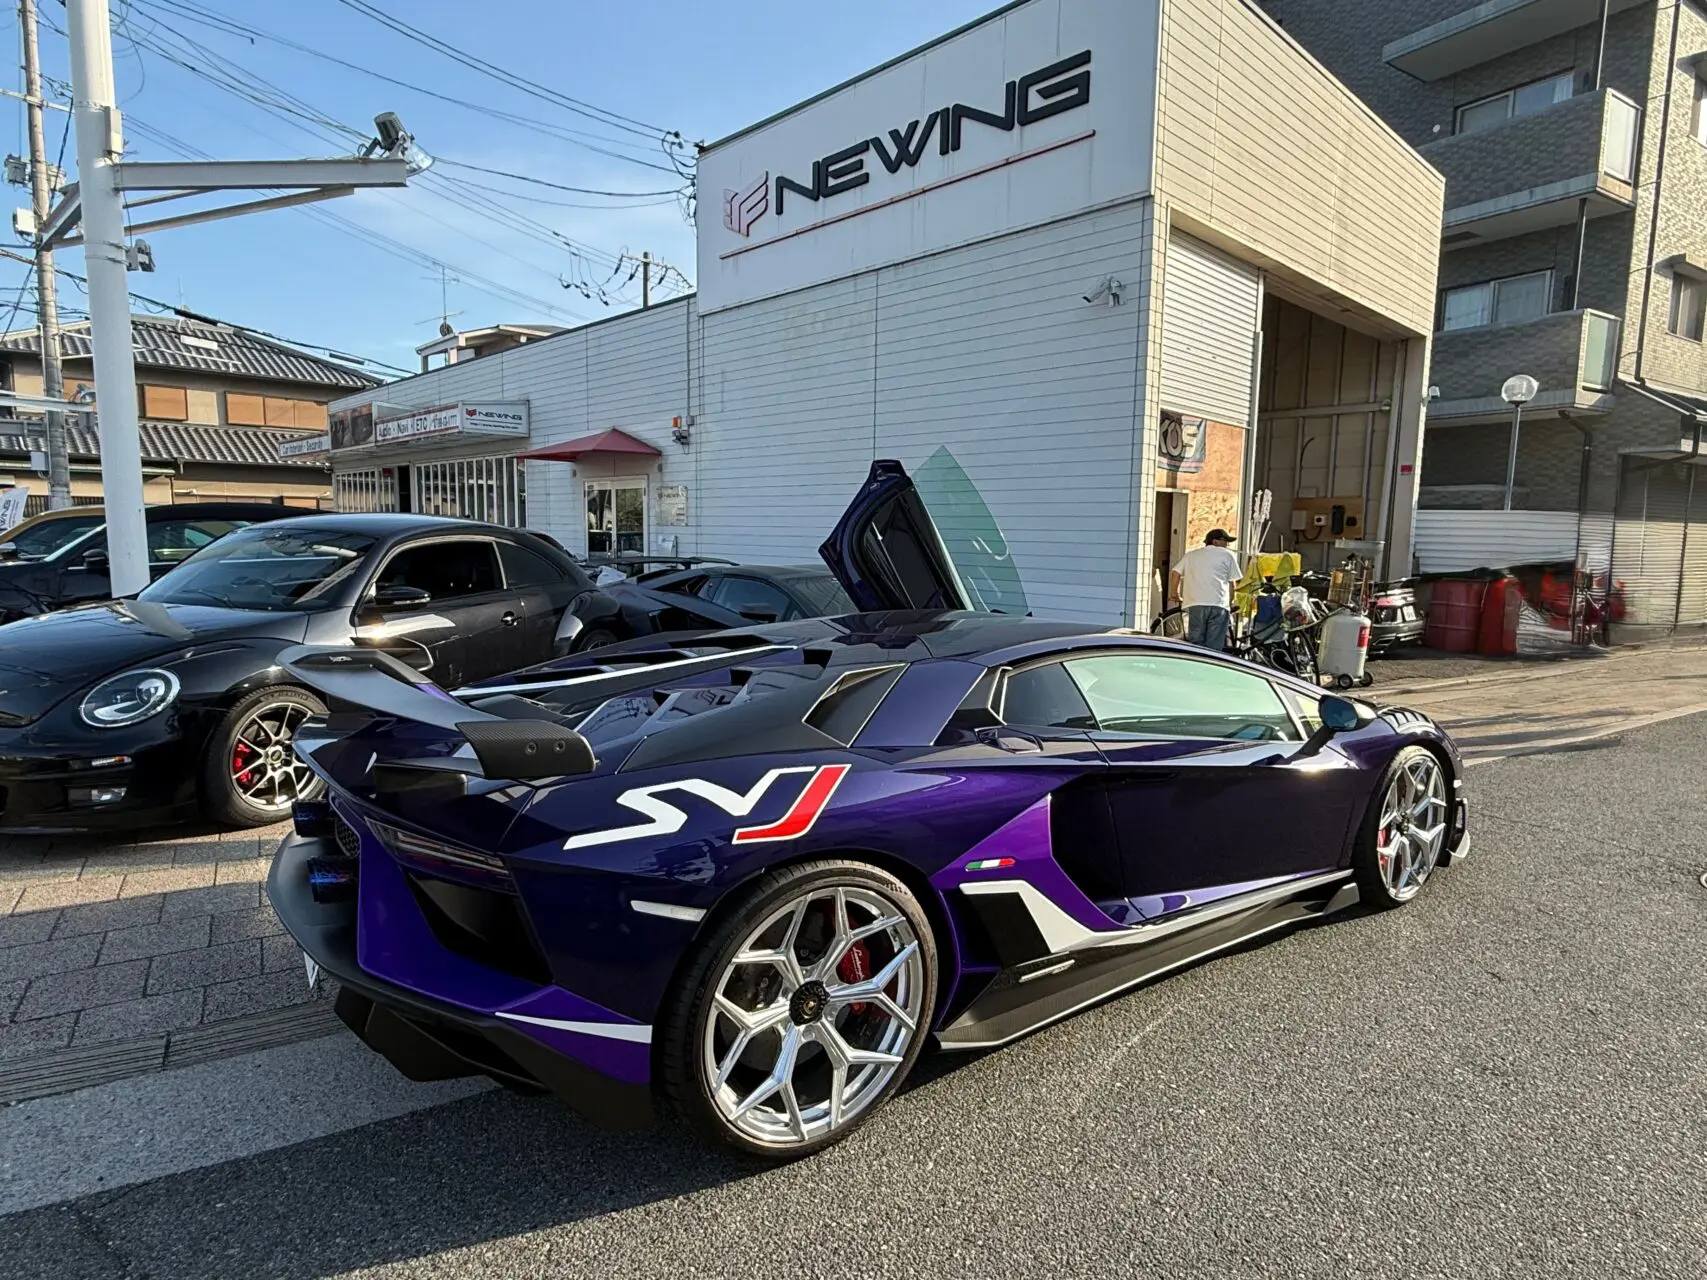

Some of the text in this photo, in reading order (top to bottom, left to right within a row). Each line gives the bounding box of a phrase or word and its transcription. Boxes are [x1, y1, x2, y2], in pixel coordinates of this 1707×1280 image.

[775, 49, 1091, 215] NEWING
[416, 416, 428, 431] ETC
[478, 411, 523, 421] NEWING
[563, 764, 852, 850] SVJ
